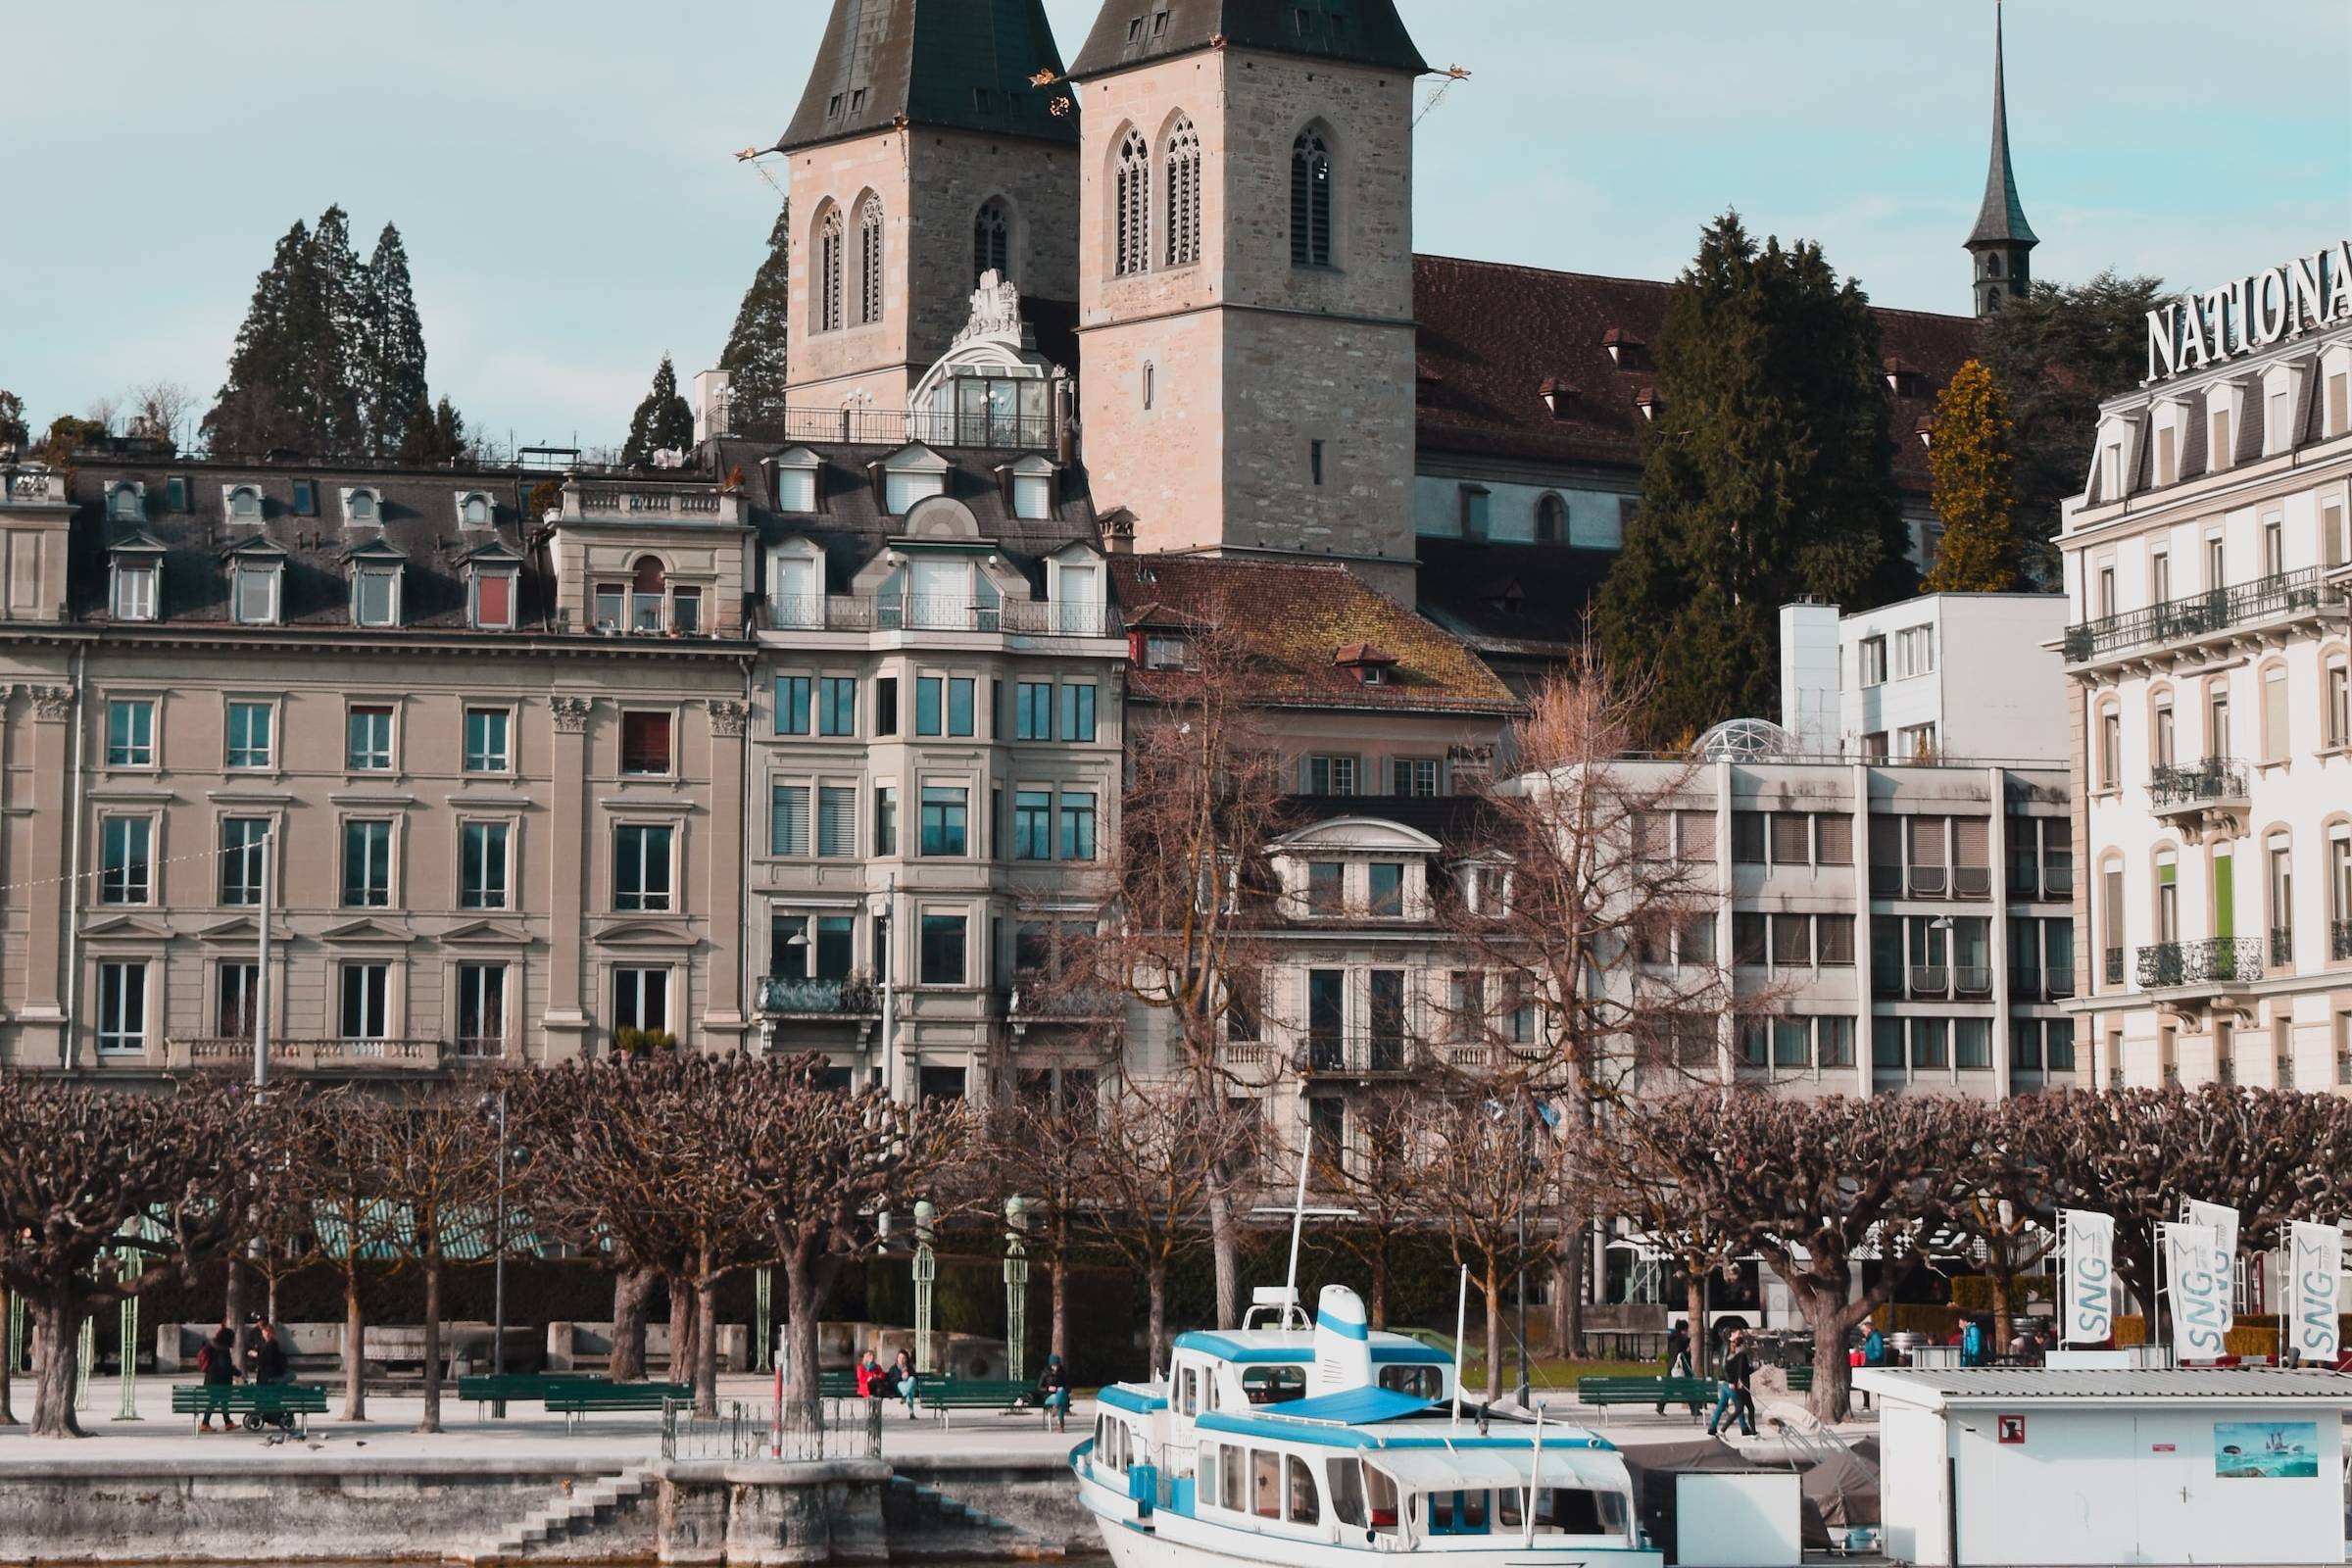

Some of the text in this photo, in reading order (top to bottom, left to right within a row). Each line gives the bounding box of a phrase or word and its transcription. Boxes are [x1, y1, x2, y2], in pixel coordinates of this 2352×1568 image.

[2145, 240, 2352, 381] NATIONA
[2078, 1256, 2107, 1337] SNG
[2181, 1270, 2221, 1352] SNG
[2303, 1270, 2333, 1353] SNG
